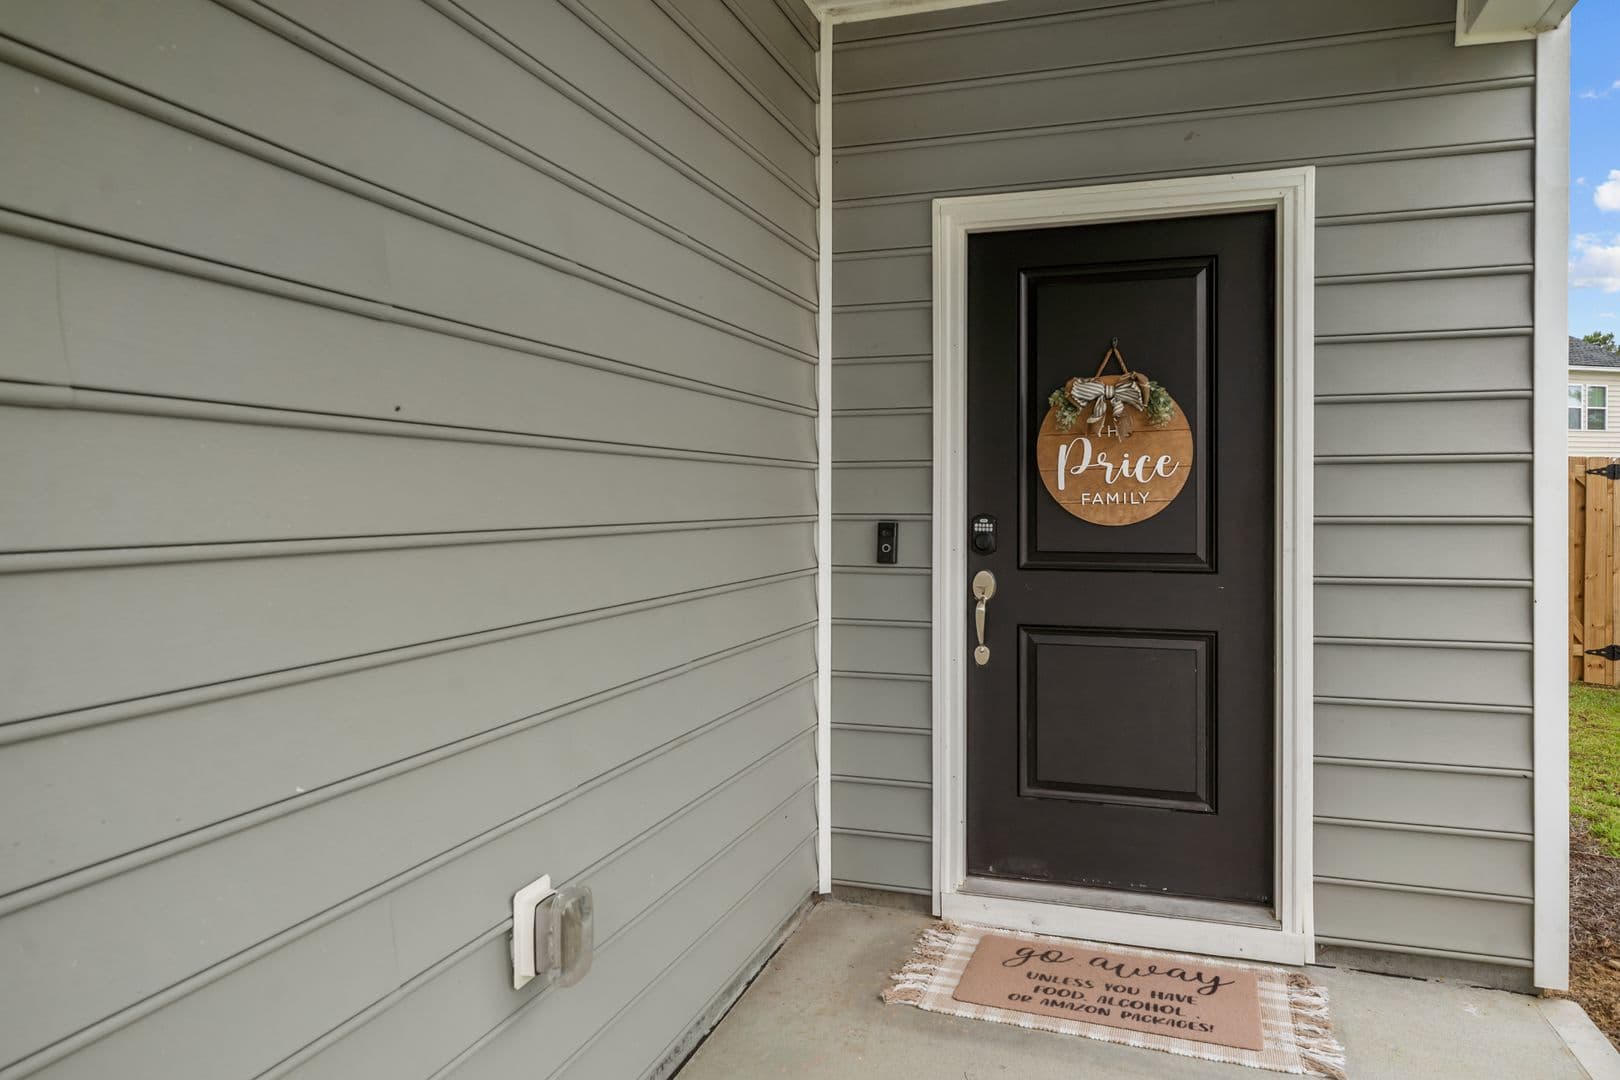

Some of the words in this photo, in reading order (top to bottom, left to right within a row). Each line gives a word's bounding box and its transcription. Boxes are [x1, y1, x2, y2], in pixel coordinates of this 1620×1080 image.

[1058, 437, 1180, 490] Price
[1082, 492, 1150, 505] FAMILY
[1002, 947, 1074, 968] go
[1089, 957, 1235, 995] away
[1026, 971, 1095, 989] UNLESS
[1105, 983, 1140, 995] YOU
[1150, 990, 1198, 1005] HAVE
[1008, 993, 1032, 1002] OR
[1040, 998, 1111, 1016] AMAZON
[1121, 1010, 1214, 1033] PACKAGES!
